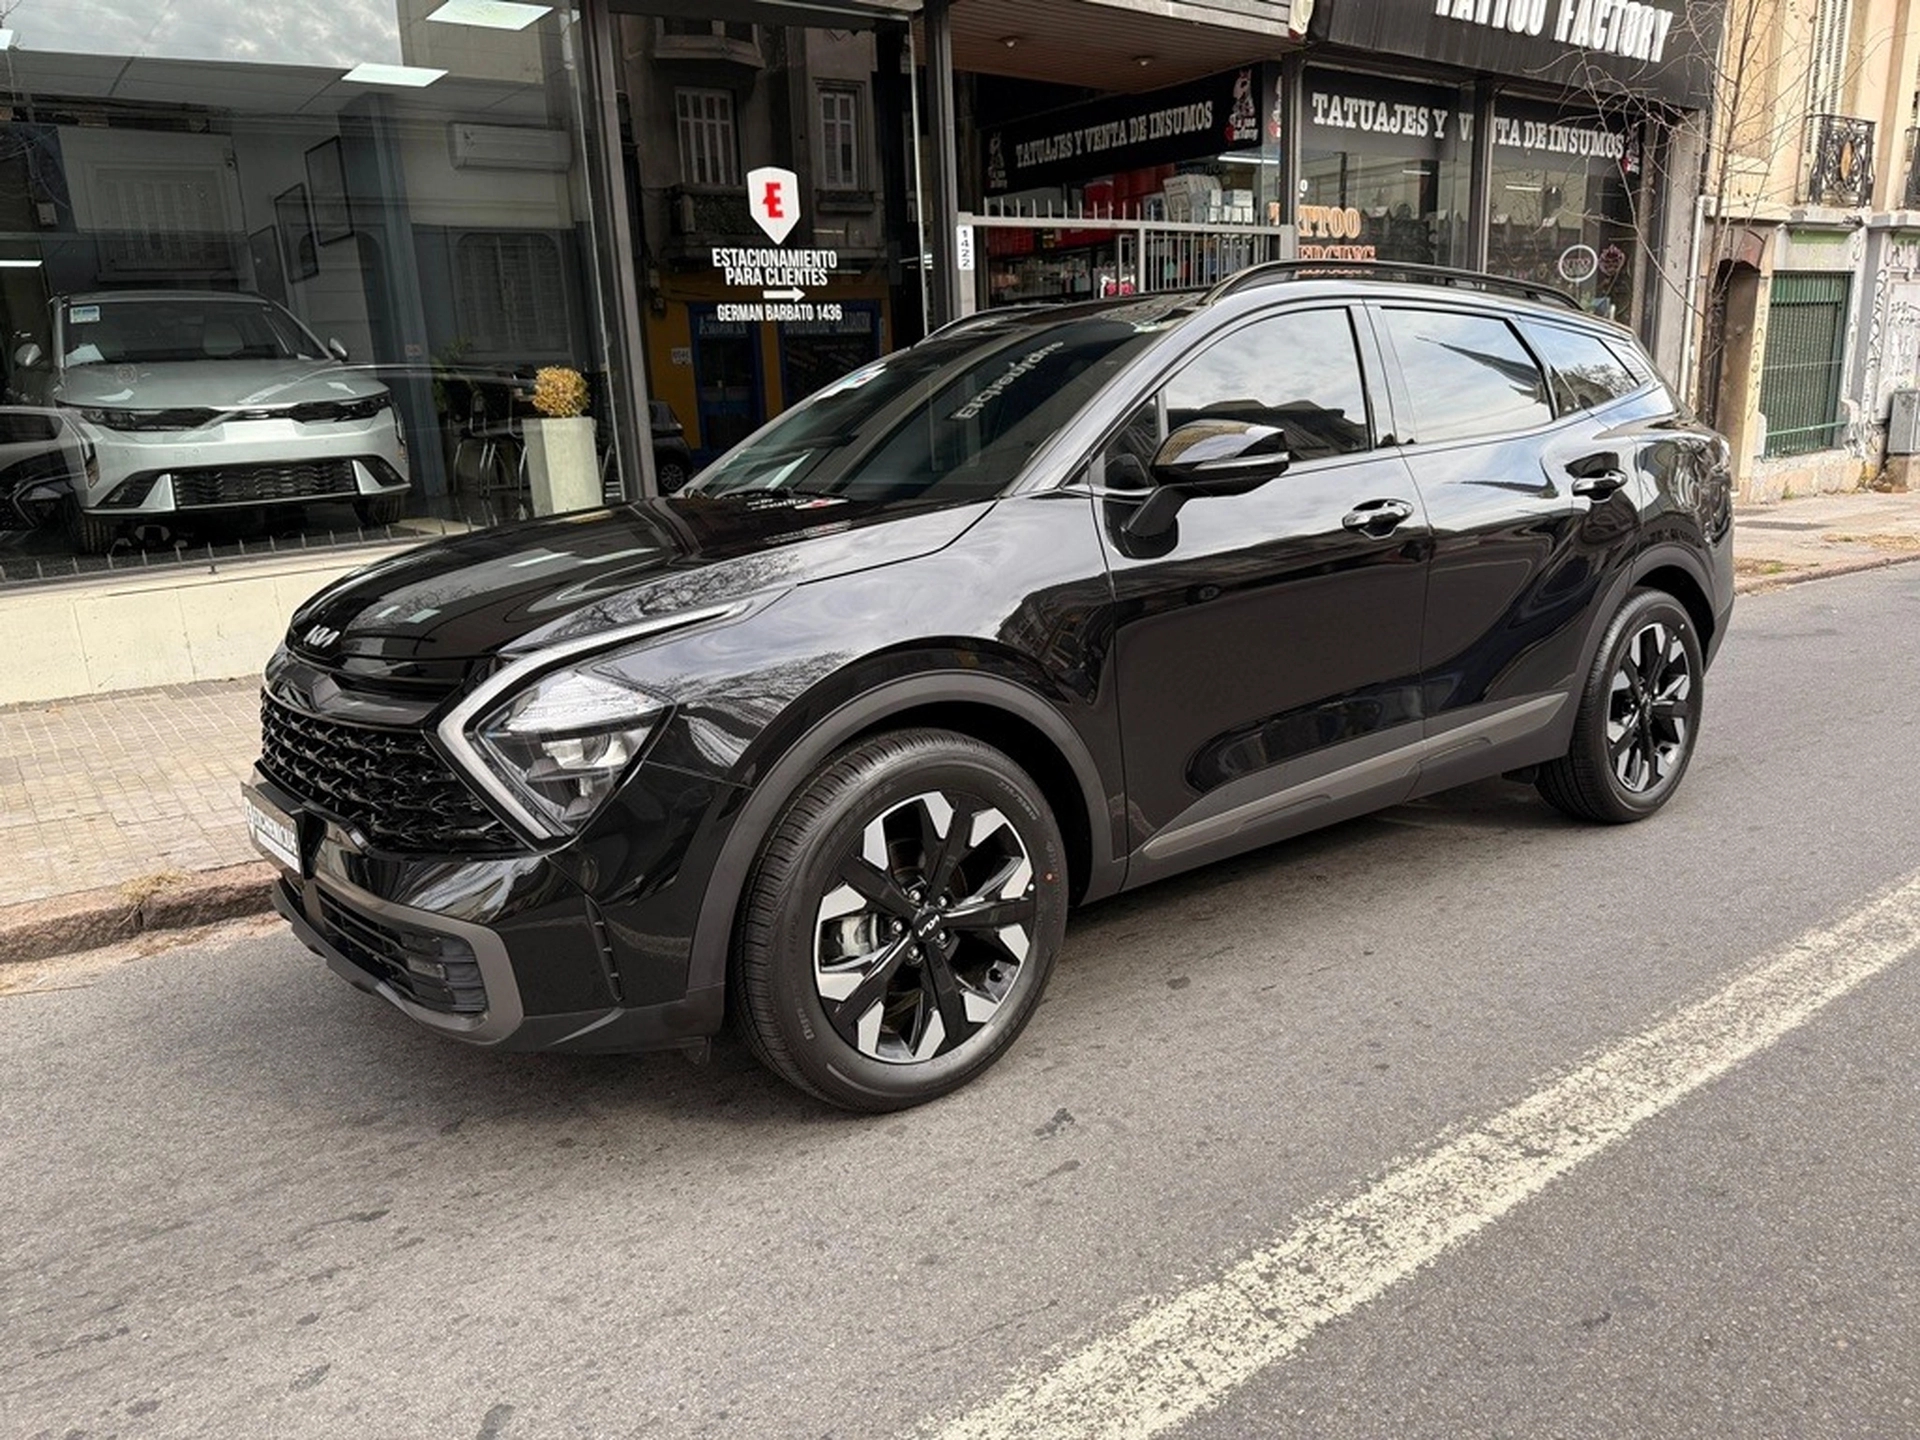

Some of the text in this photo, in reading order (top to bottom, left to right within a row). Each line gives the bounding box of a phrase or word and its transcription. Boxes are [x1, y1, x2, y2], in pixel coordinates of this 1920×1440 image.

[1554, 0, 1673, 63] FACTORY
[1015, 132, 1073, 168] TATUAJES
[1074, 129, 1086, 156] Y
[1085, 119, 1127, 153] VENTA
[1129, 115, 1147, 142] DE
[1149, 100, 1213, 141] INSUMOS
[1312, 93, 1625, 158] TATUAJES Y VTA DE INSUMOS
[762, 182, 785, 218] E
[712, 248, 837, 268] ESTACIONAMIENTO
[960, 229, 971, 268] 1422
[725, 268, 828, 287] PARA CLIENTES
[717, 303, 843, 322] GERMAN BARBATO 1436
